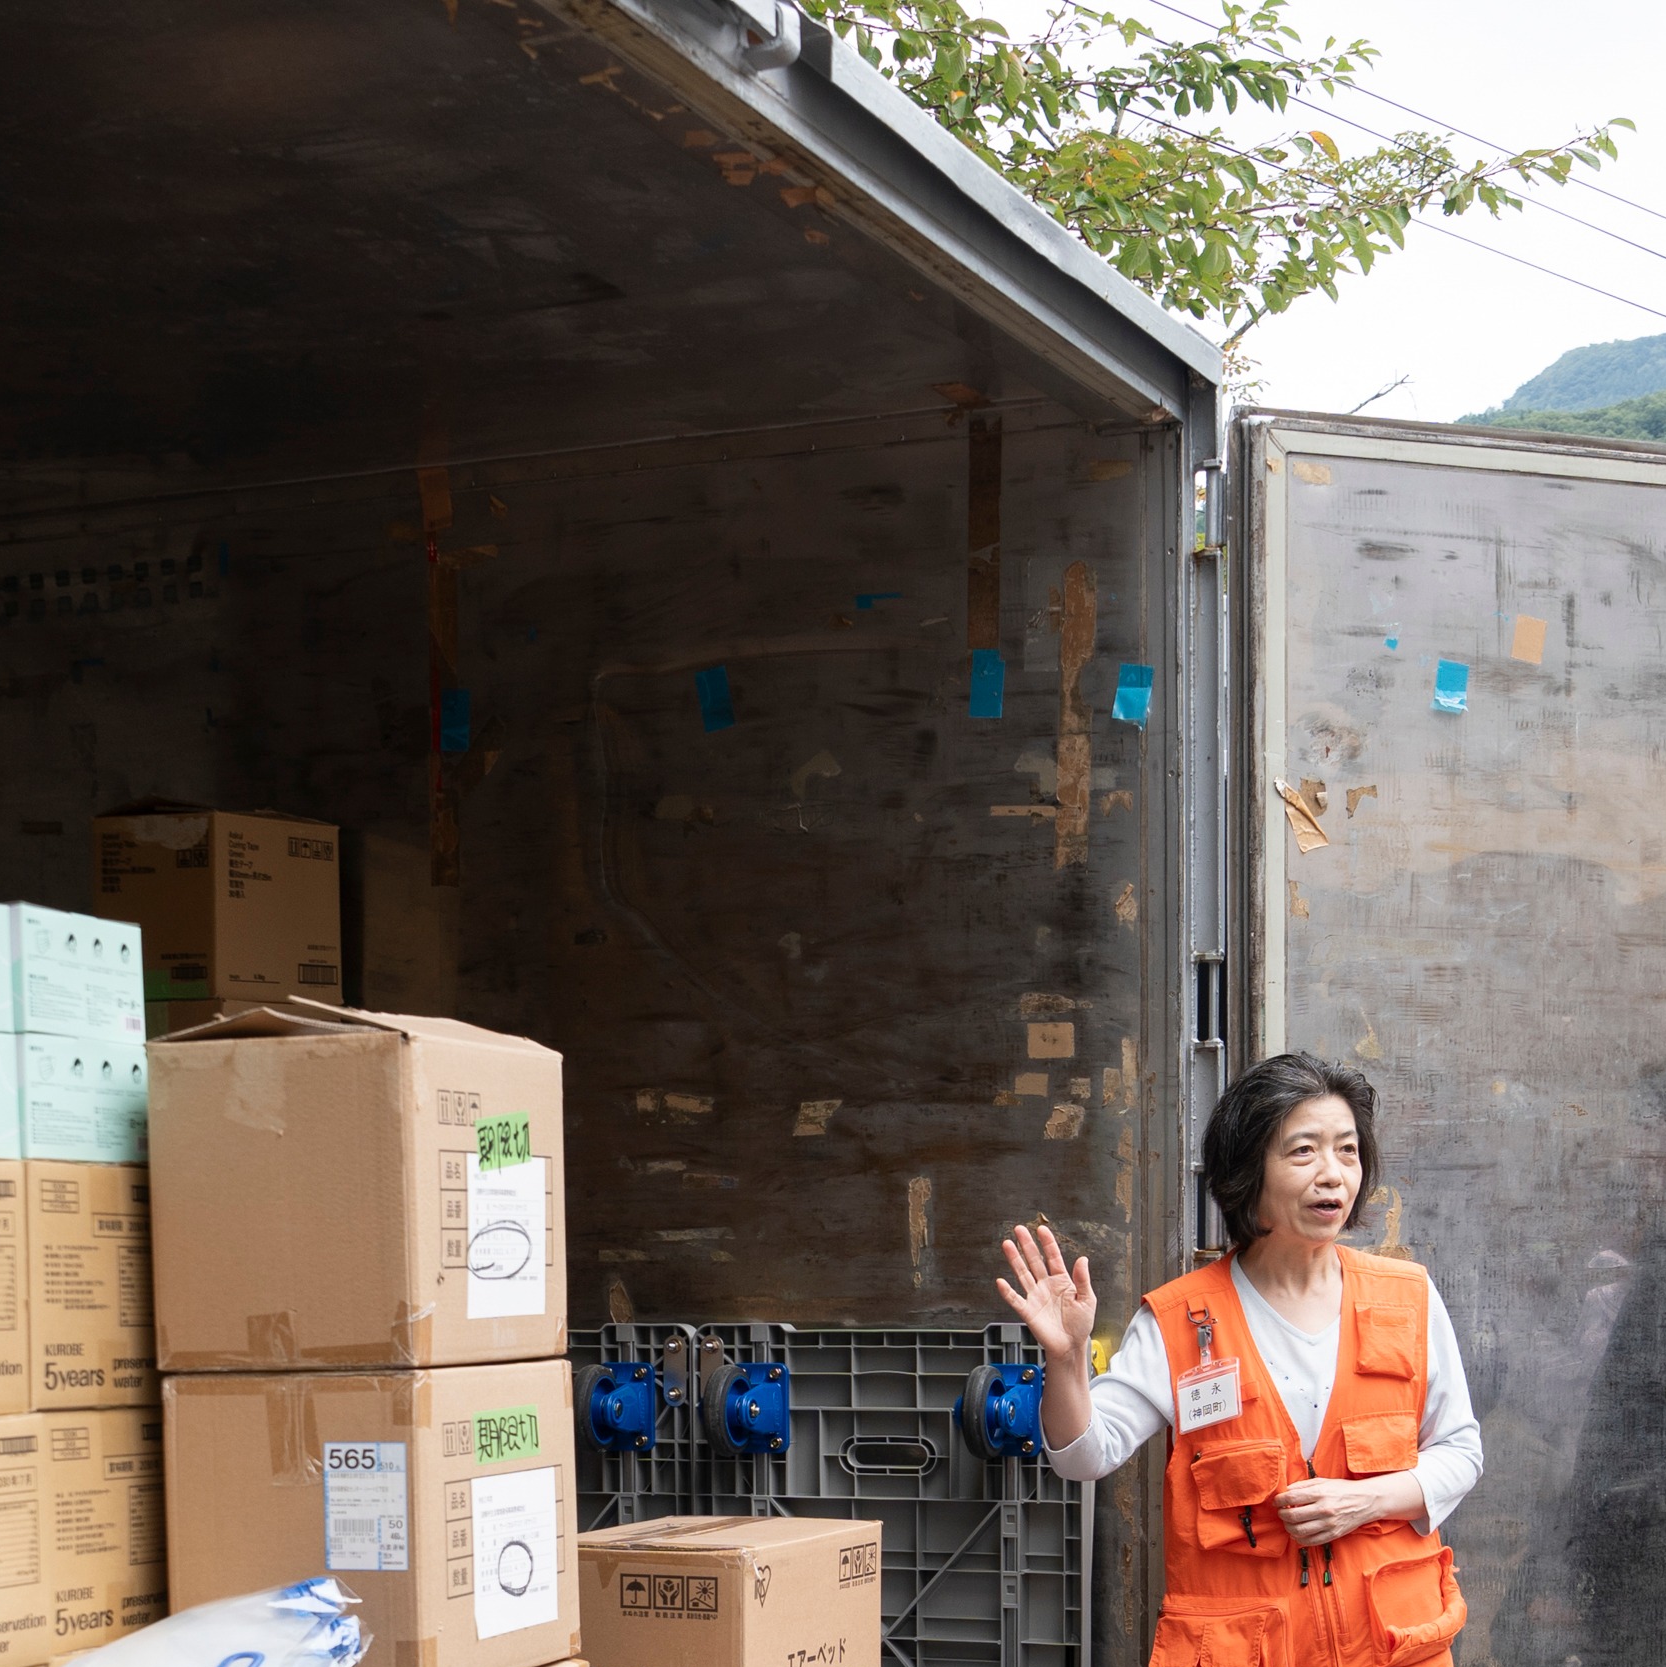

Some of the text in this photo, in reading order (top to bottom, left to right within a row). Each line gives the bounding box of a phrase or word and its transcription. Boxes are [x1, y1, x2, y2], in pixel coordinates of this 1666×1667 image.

[44, 1342, 85, 1357] KUROBE
[44, 1362, 106, 1392] 5years
[113, 1376, 145, 1389] water
[1187, 1399, 1228, 1423] (神岡町)
[476, 1413, 540, 1463] 期限切
[328, 1448, 376, 1470] 565
[388, 1519, 404, 1530] 50
[55, 1586, 95, 1604] KUROBE
[55, 1607, 114, 1637] 5years
[121, 1611, 152, 1627] water
[654, 1612, 684, 1620] 取扱注意
